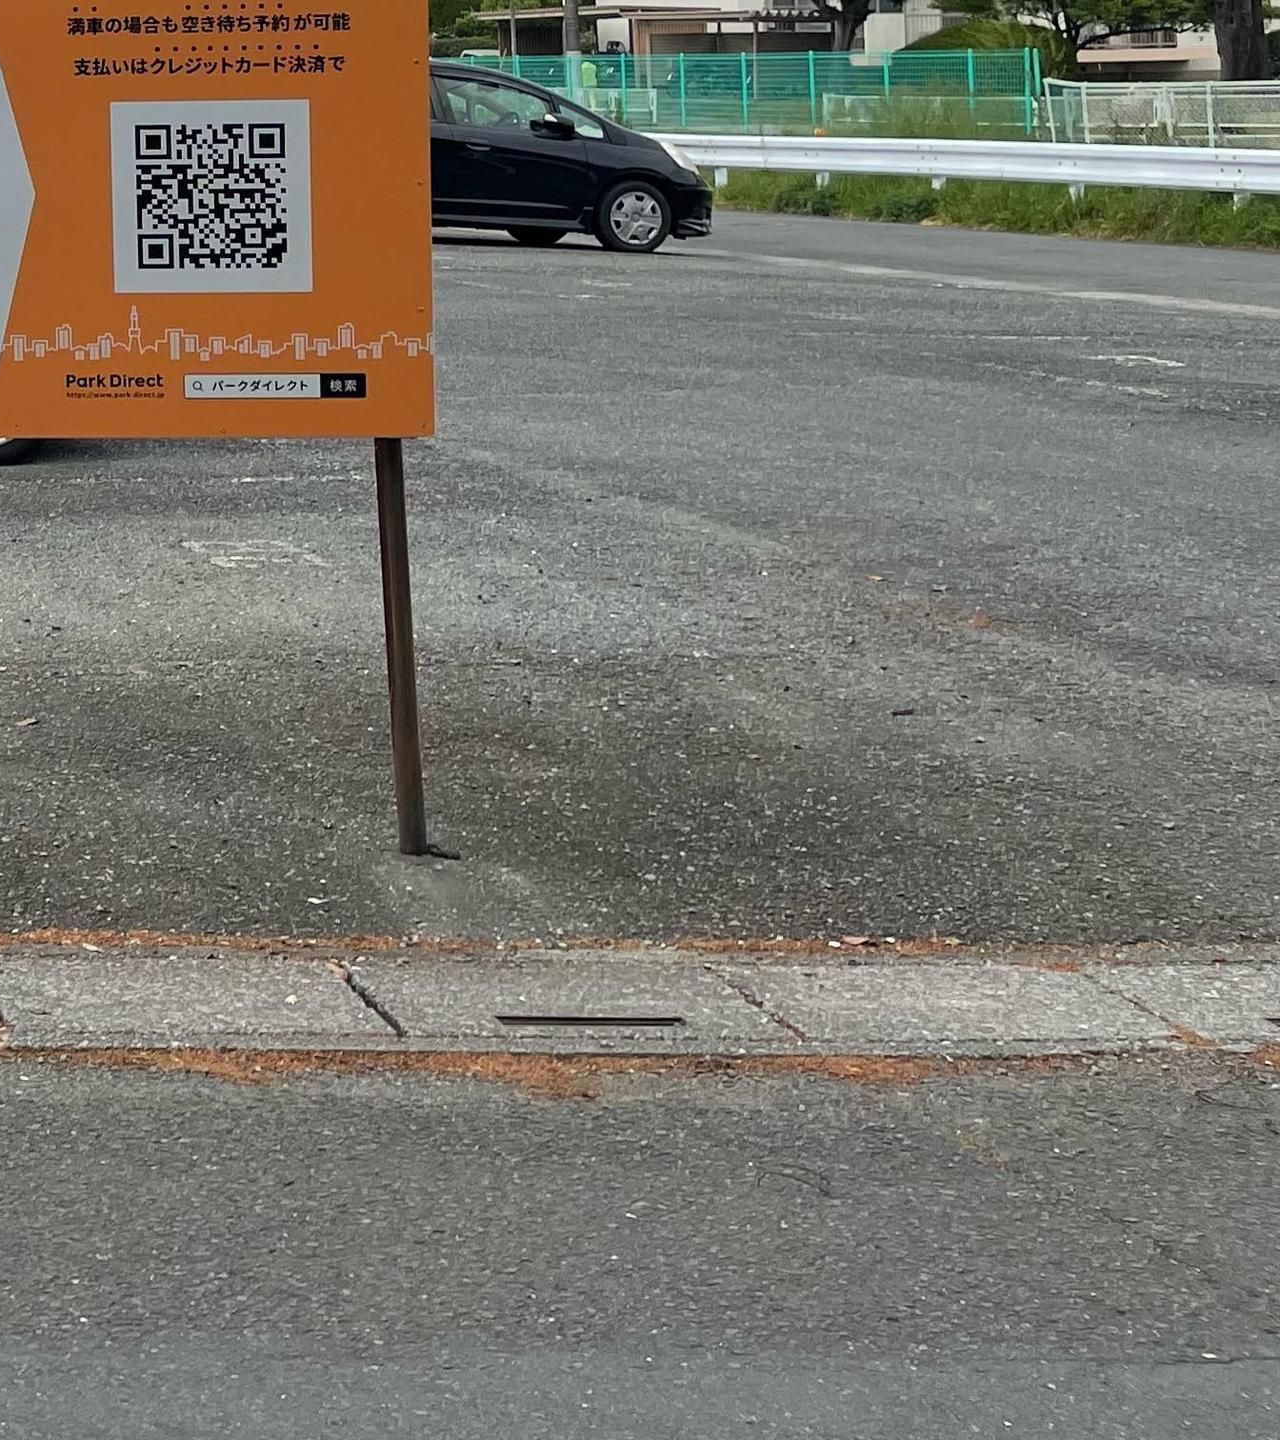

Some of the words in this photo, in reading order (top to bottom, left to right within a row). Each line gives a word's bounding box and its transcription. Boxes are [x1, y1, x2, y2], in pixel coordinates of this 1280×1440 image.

[67, 12, 351, 36] 満車の場合も空き待ち予約が可能
[73, 55, 345, 76] 支払いはクレジットカード決済で
[66, 374, 107, 388] Park
[109, 373, 164, 388] Direct
[212, 379, 309, 392] パークダイレクト
[329, 378, 357, 393] 検索
